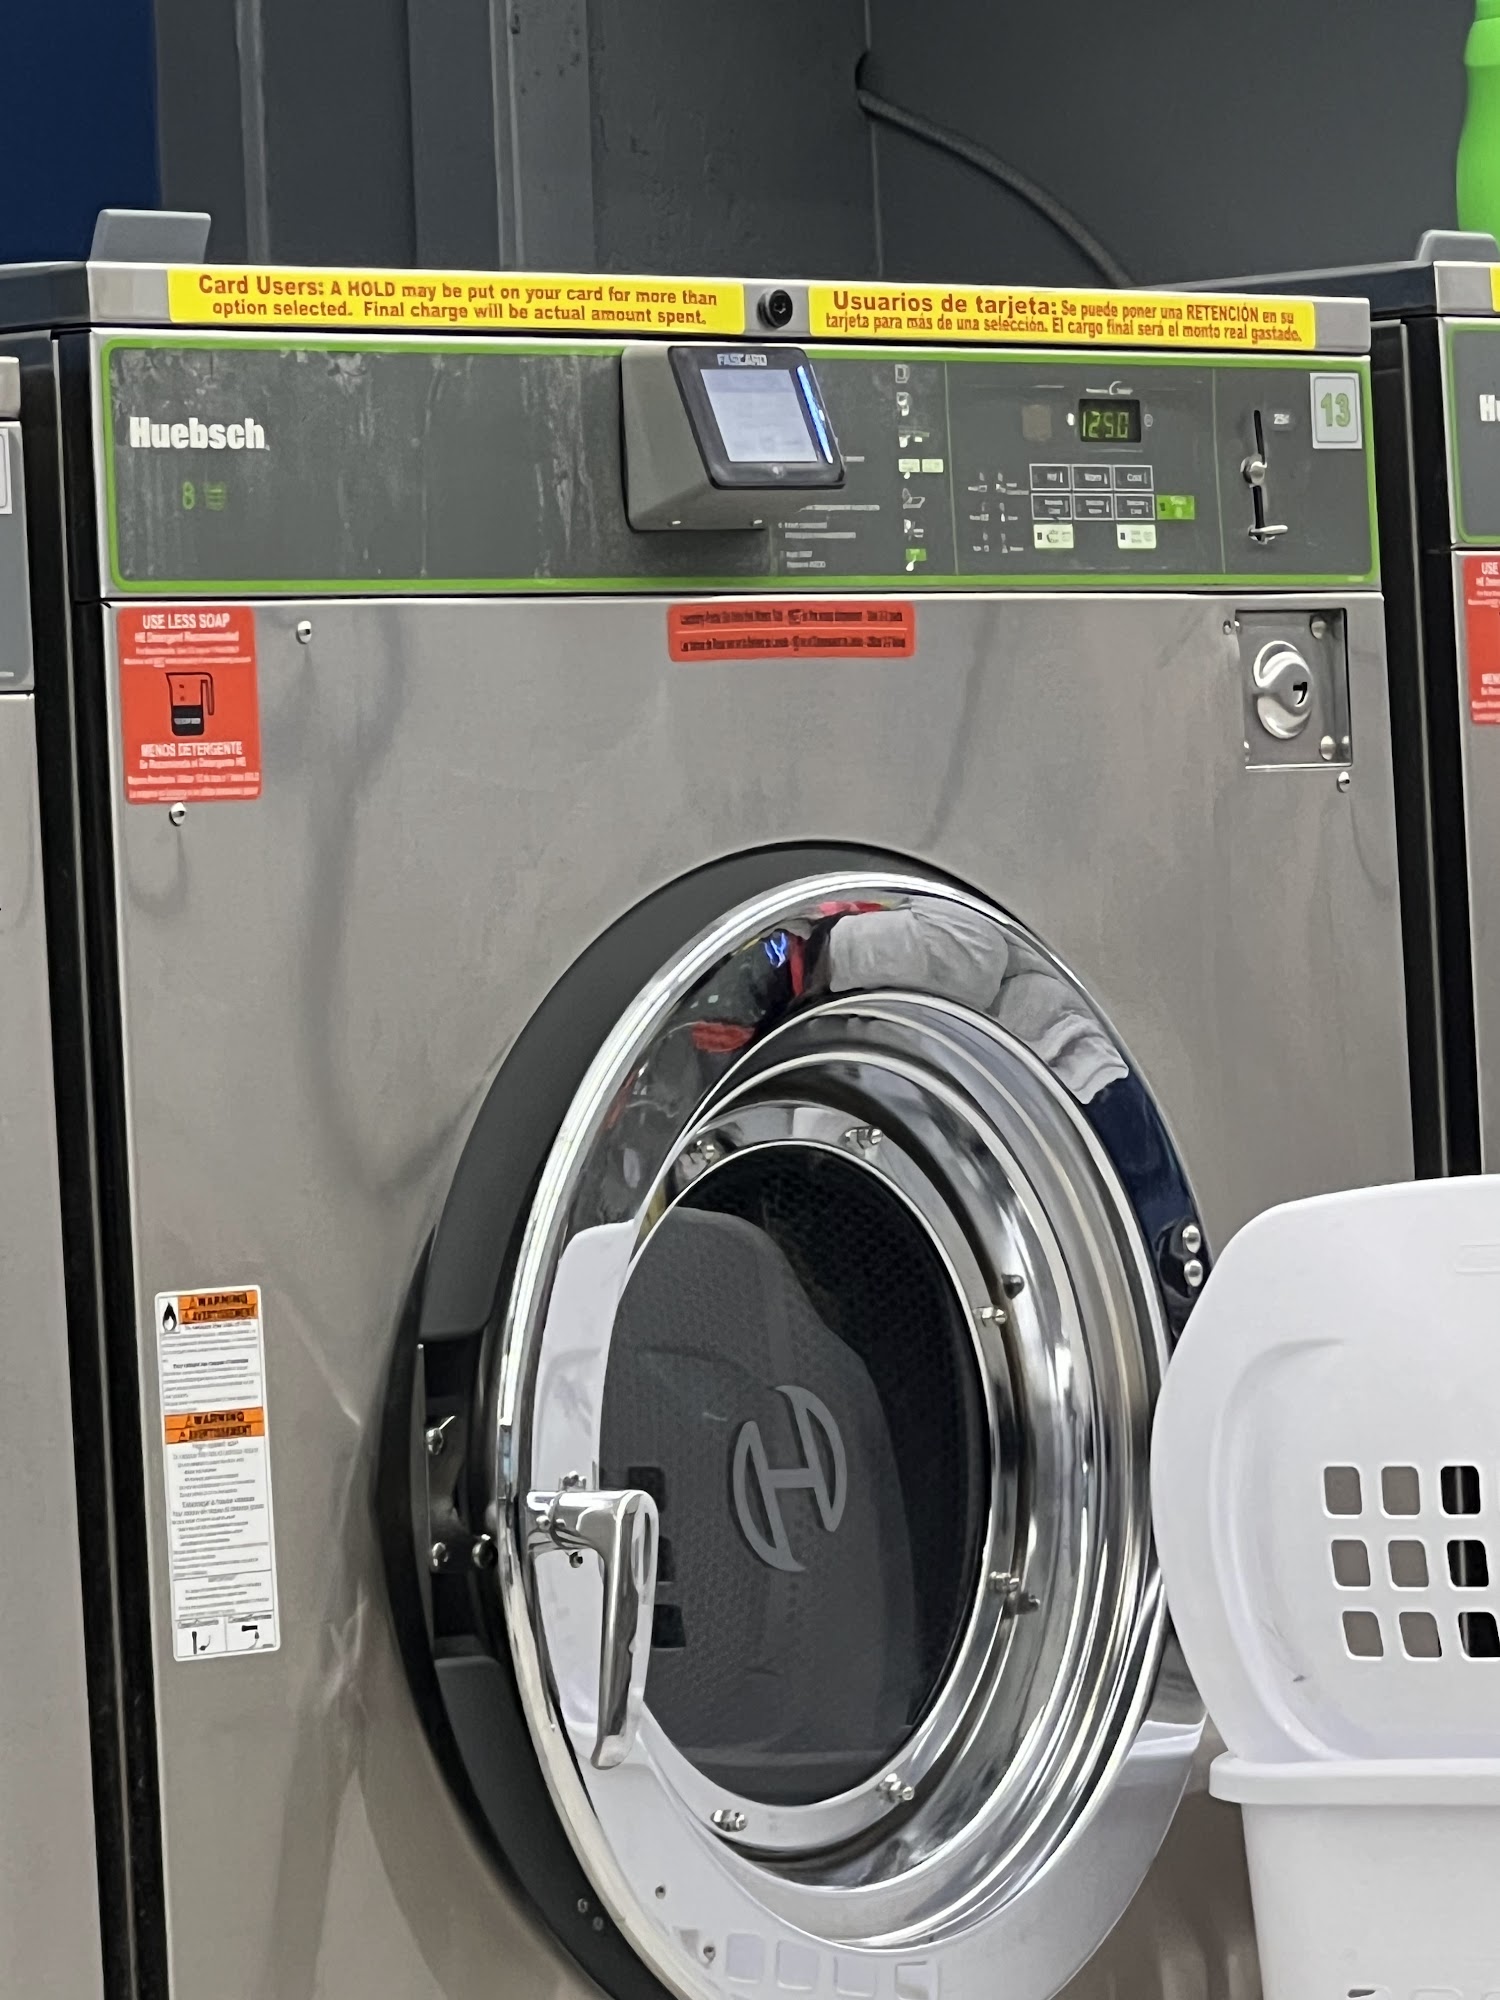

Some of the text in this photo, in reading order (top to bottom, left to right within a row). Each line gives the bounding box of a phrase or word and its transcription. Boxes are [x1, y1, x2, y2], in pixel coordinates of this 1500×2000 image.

[199, 274, 717, 306] Card Users: A HOLD may be put on your card for more than
[213, 299, 707, 328] option selected. Final charge will be actual amount spent.
[833, 290, 1295, 325] Usuarios de tarjeta: Se puede poner una RETENCIÓN en su
[826, 311, 870, 333] tarjeta
[874, 314, 902, 334] para
[907, 312, 933, 330] más
[937, 315, 953, 331] de
[957, 317, 980, 331] una
[983, 315, 1048, 332] selección.
[1052, 316, 1064, 333] El
[1067, 319, 1103, 338] cargo
[1107, 319, 1134, 336] final
[1138, 320, 1164, 337] será
[1168, 321, 1179, 337] el
[1182, 323, 1221, 338] monto
[1224, 322, 1247, 339] real
[1320, 392, 1351, 428] 13
[129, 416, 265, 450] Huebsch
[142, 612, 231, 629] USE LESS SOAP
[177, 741, 243, 757] DETERGENTE
